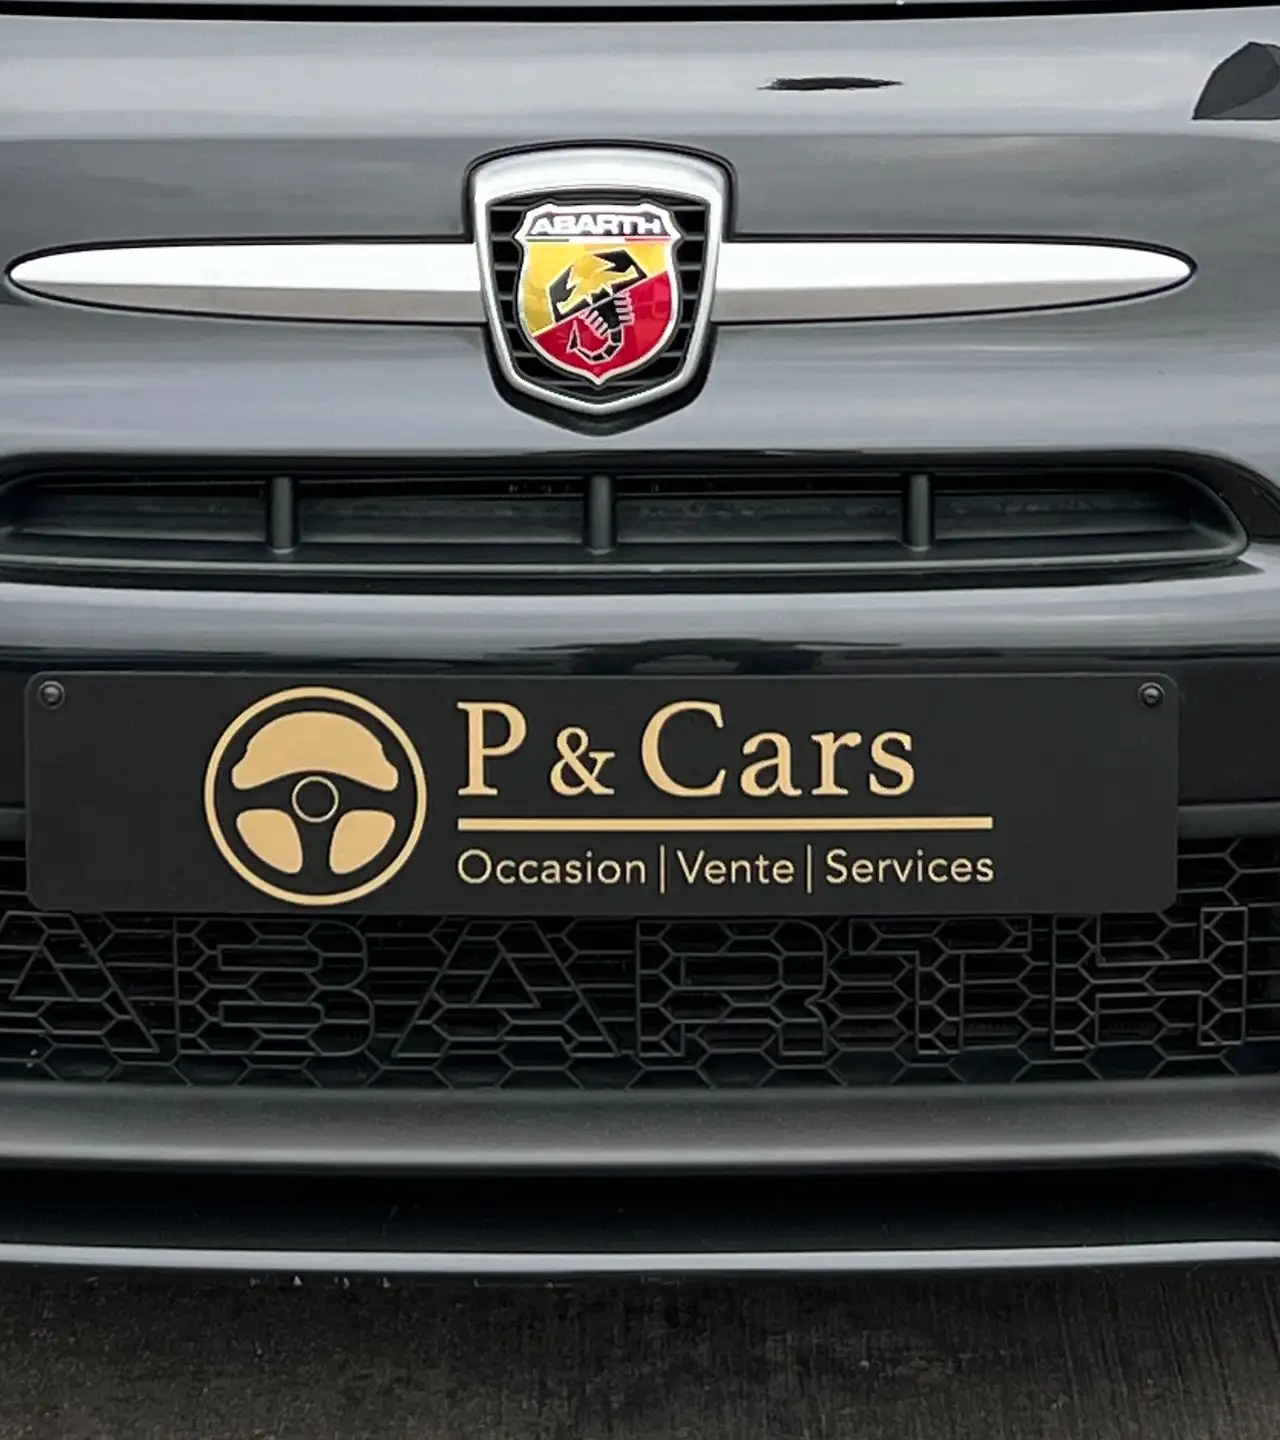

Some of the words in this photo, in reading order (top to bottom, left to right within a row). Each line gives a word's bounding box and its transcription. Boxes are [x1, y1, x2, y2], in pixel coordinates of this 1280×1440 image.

[530, 213, 661, 235] ABARTH
[458, 700, 527, 796] P
[549, 726, 612, 796] &
[642, 700, 915, 797] Cars
[457, 848, 647, 885] Occasion
[676, 848, 795, 885] Vente
[825, 848, 994, 885] Services
